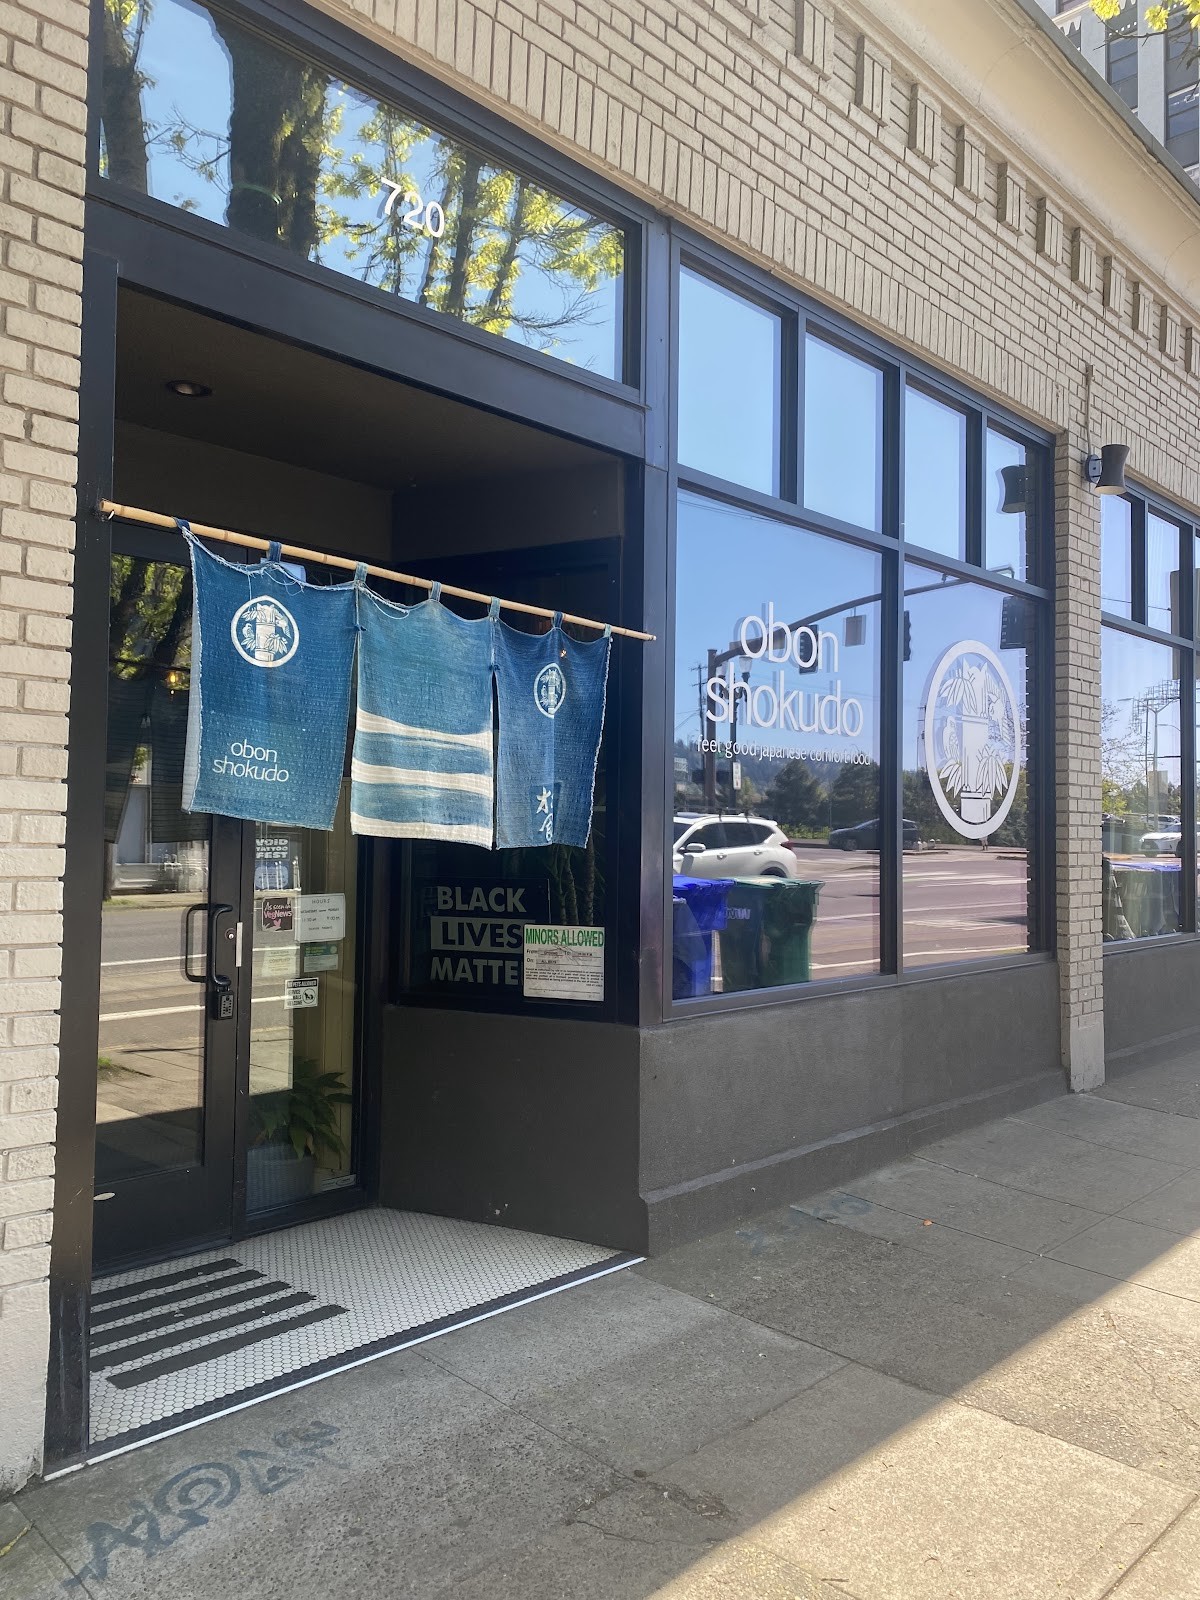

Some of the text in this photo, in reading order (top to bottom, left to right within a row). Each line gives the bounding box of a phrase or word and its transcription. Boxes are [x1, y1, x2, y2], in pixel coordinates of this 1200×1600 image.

[381, 176, 445, 238] 720
[740, 601, 839, 673] obon
[705, 661, 864, 737] shokudo
[230, 738, 278, 763] obon
[697, 734, 871, 766] feel good japanese comfort food
[212, 755, 290, 782] shokudo
[255, 838, 289, 846] VOID
[437, 885, 527, 913] BLACK
[263, 910, 293, 920] VegNews
[442, 921, 523, 949] LIVES
[525, 928, 604, 947] MINORS ALLOWED
[430, 956, 523, 986] MATTE
